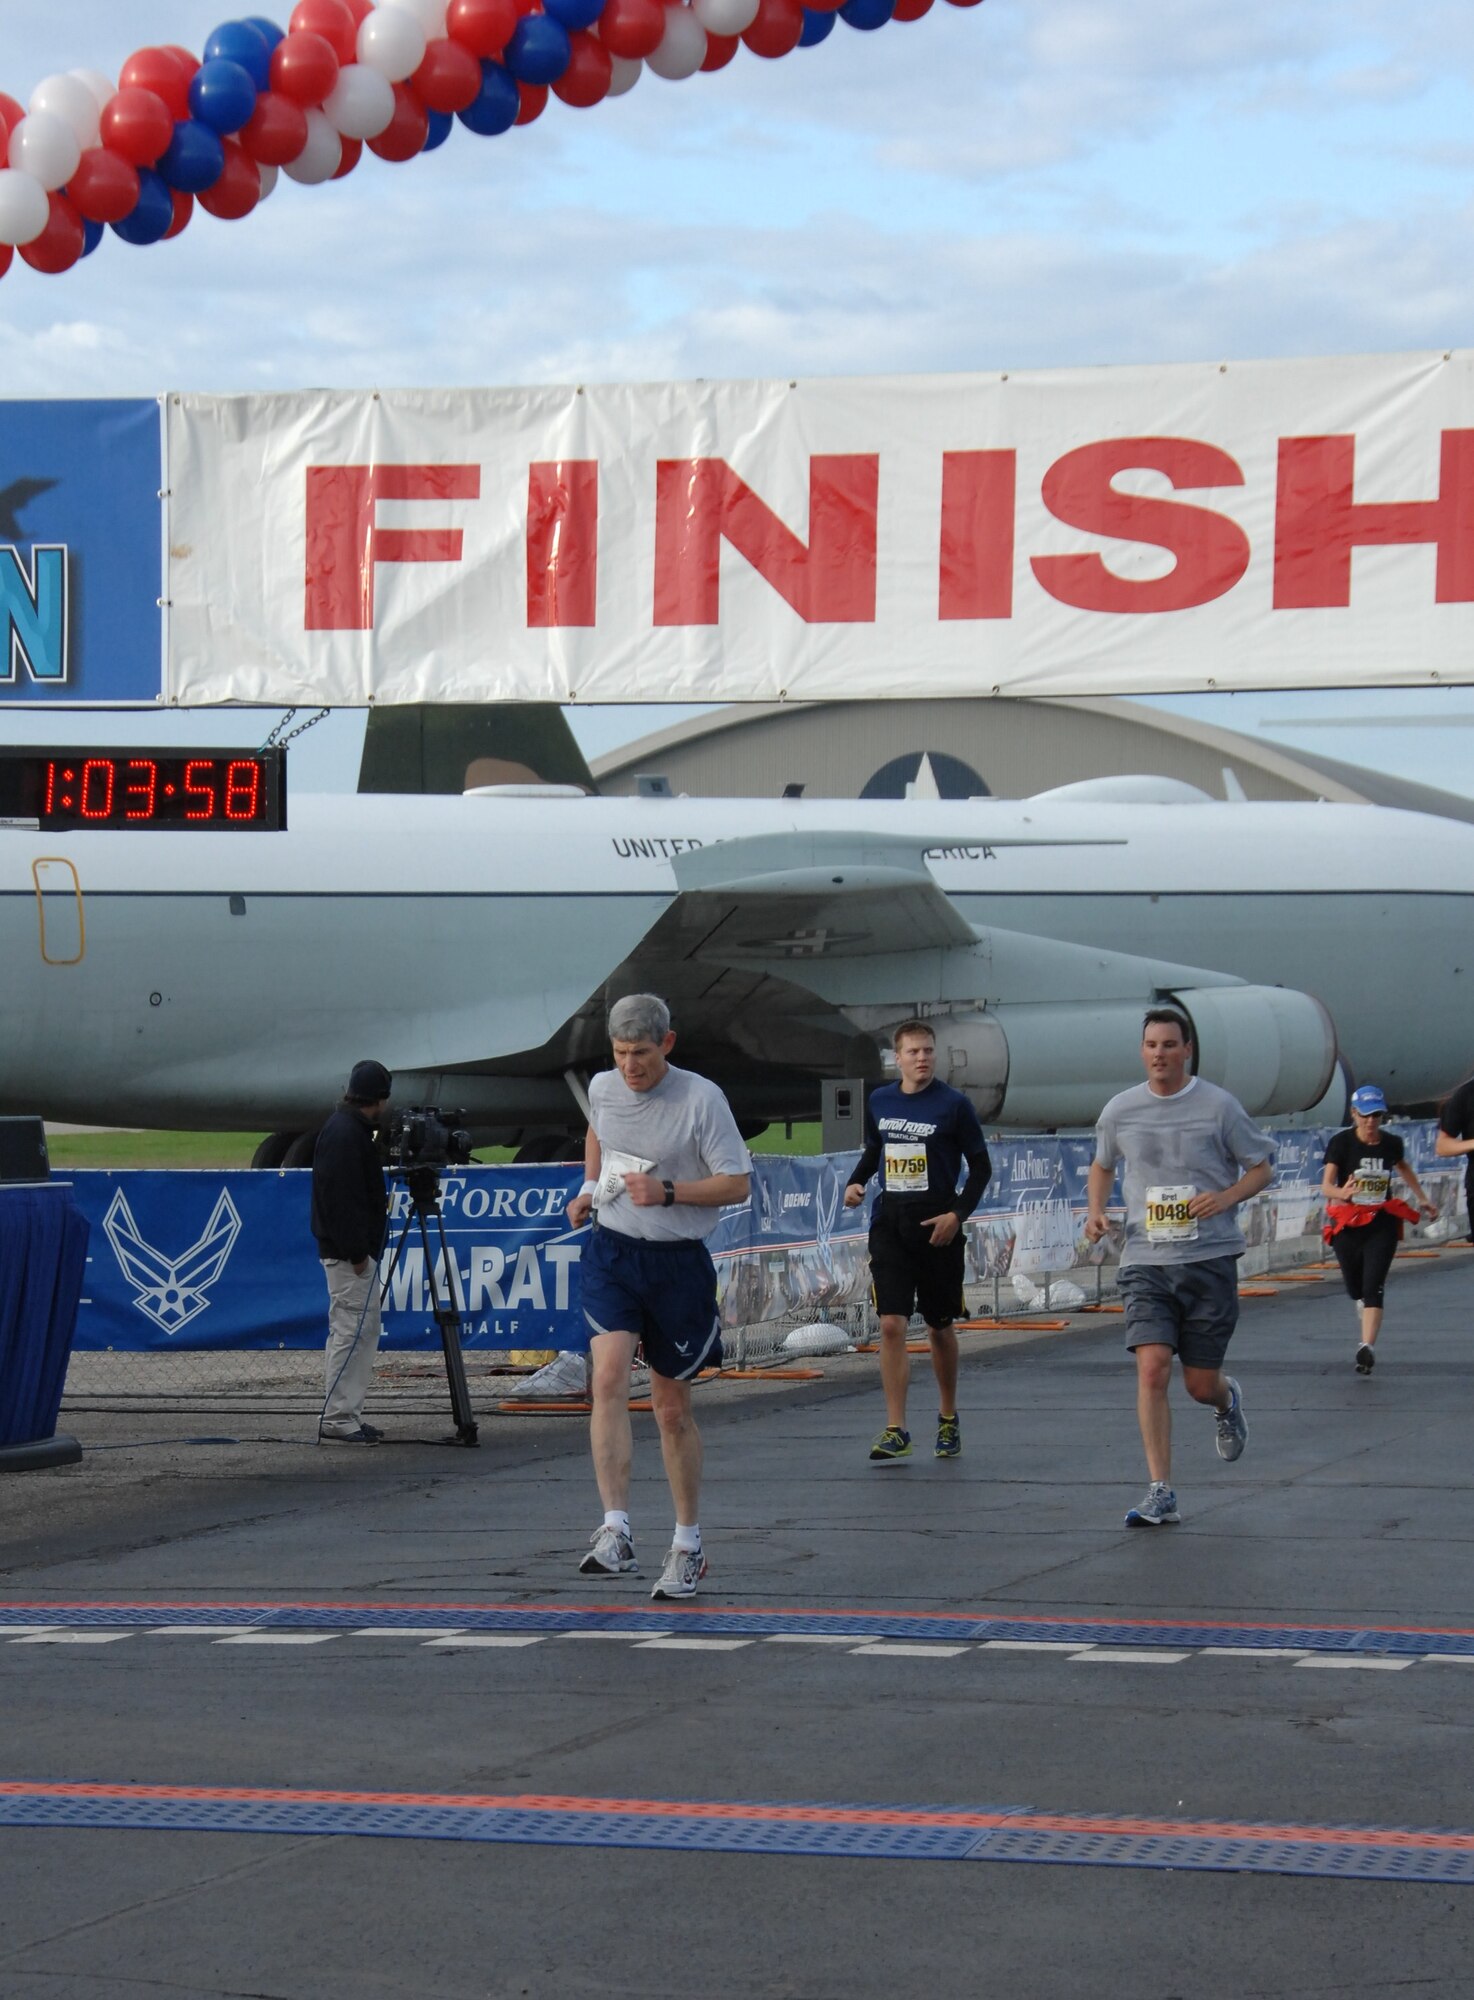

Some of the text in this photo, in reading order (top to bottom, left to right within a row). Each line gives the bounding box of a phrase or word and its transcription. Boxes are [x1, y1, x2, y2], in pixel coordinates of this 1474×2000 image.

[303, 427, 1474, 631] FINISH
[888, 1132, 919, 1141] TRIATHLON
[886, 1158, 926, 1174] 11759
[434, 1177, 568, 1219] FORCE
[784, 1192, 812, 1208] BOEING
[463, 1320, 519, 1334] HALF
